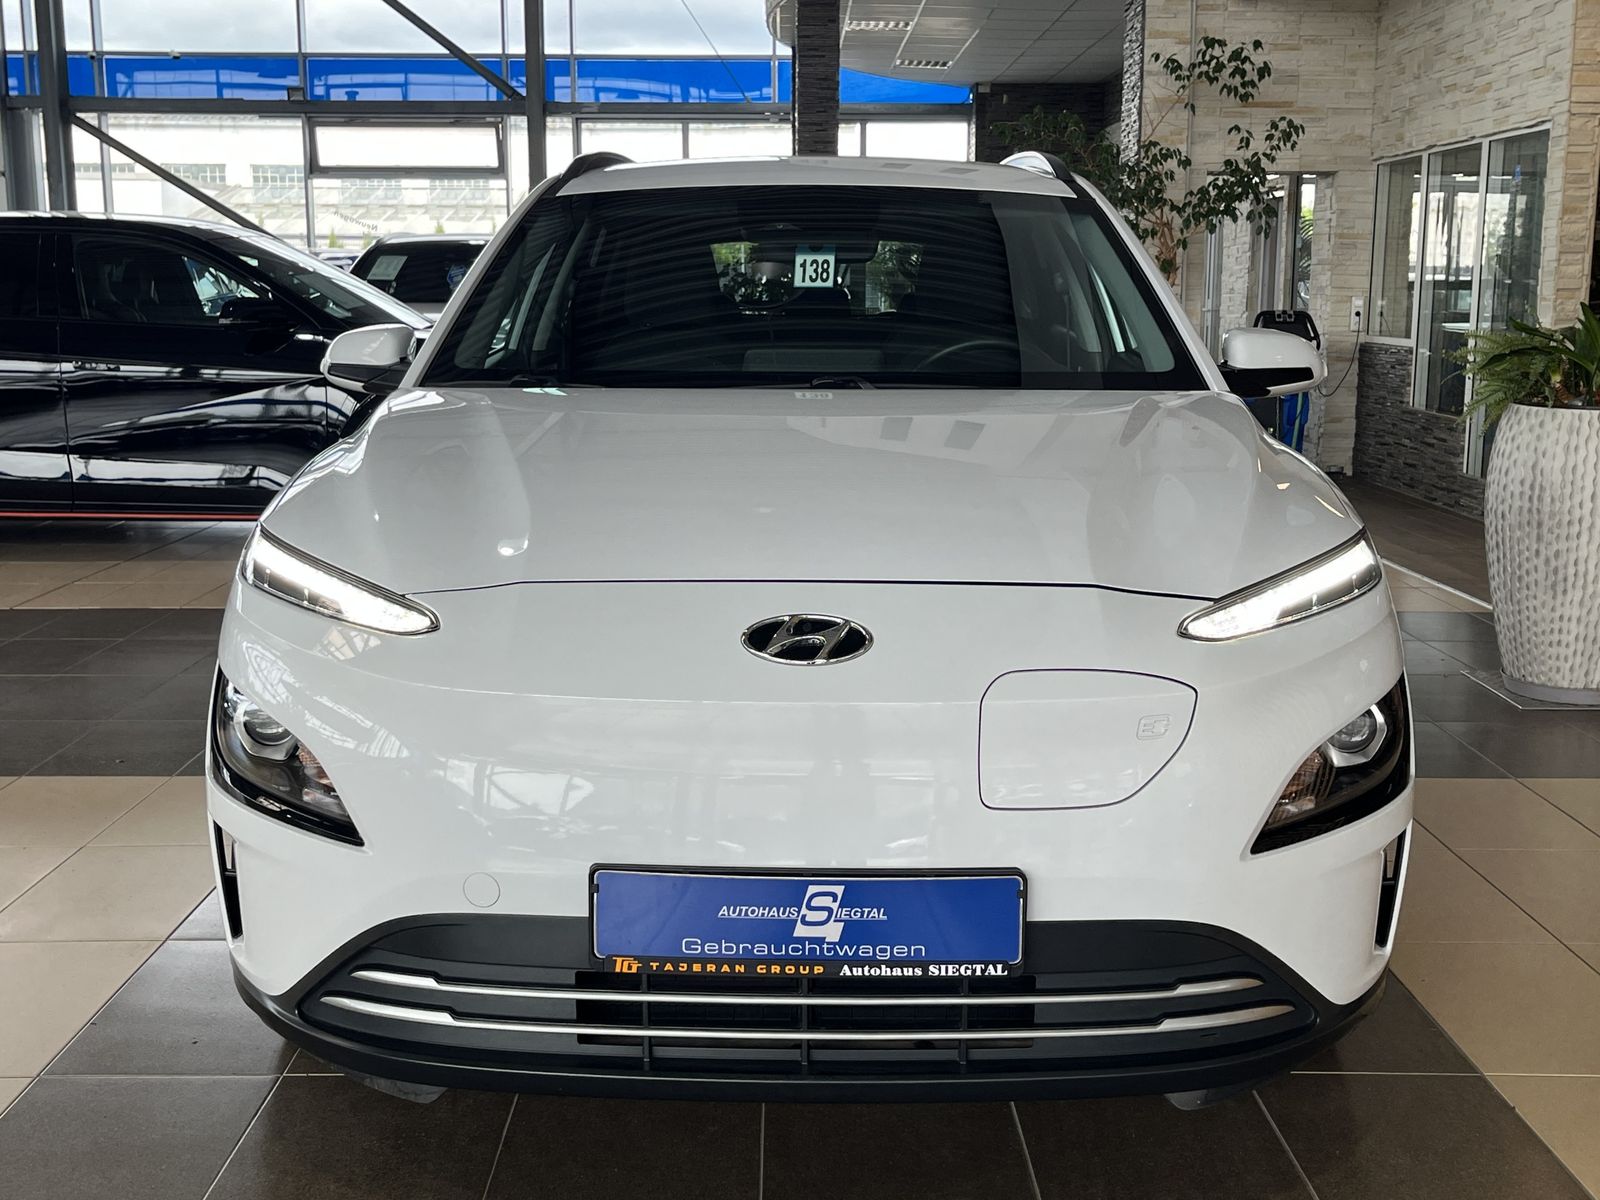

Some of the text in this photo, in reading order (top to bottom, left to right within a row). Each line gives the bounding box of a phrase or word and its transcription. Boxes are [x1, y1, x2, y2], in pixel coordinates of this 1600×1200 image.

[800, 259, 830, 283] 138
[718, 906, 799, 919] AUTOHAUS
[681, 938, 926, 960] Gebrauchtwagen
[649, 962, 745, 973] TAJERAN
[756, 964, 825, 974] GROUP
[839, 964, 923, 977] Autohaus
[928, 964, 1008, 977] SIEGTAL
